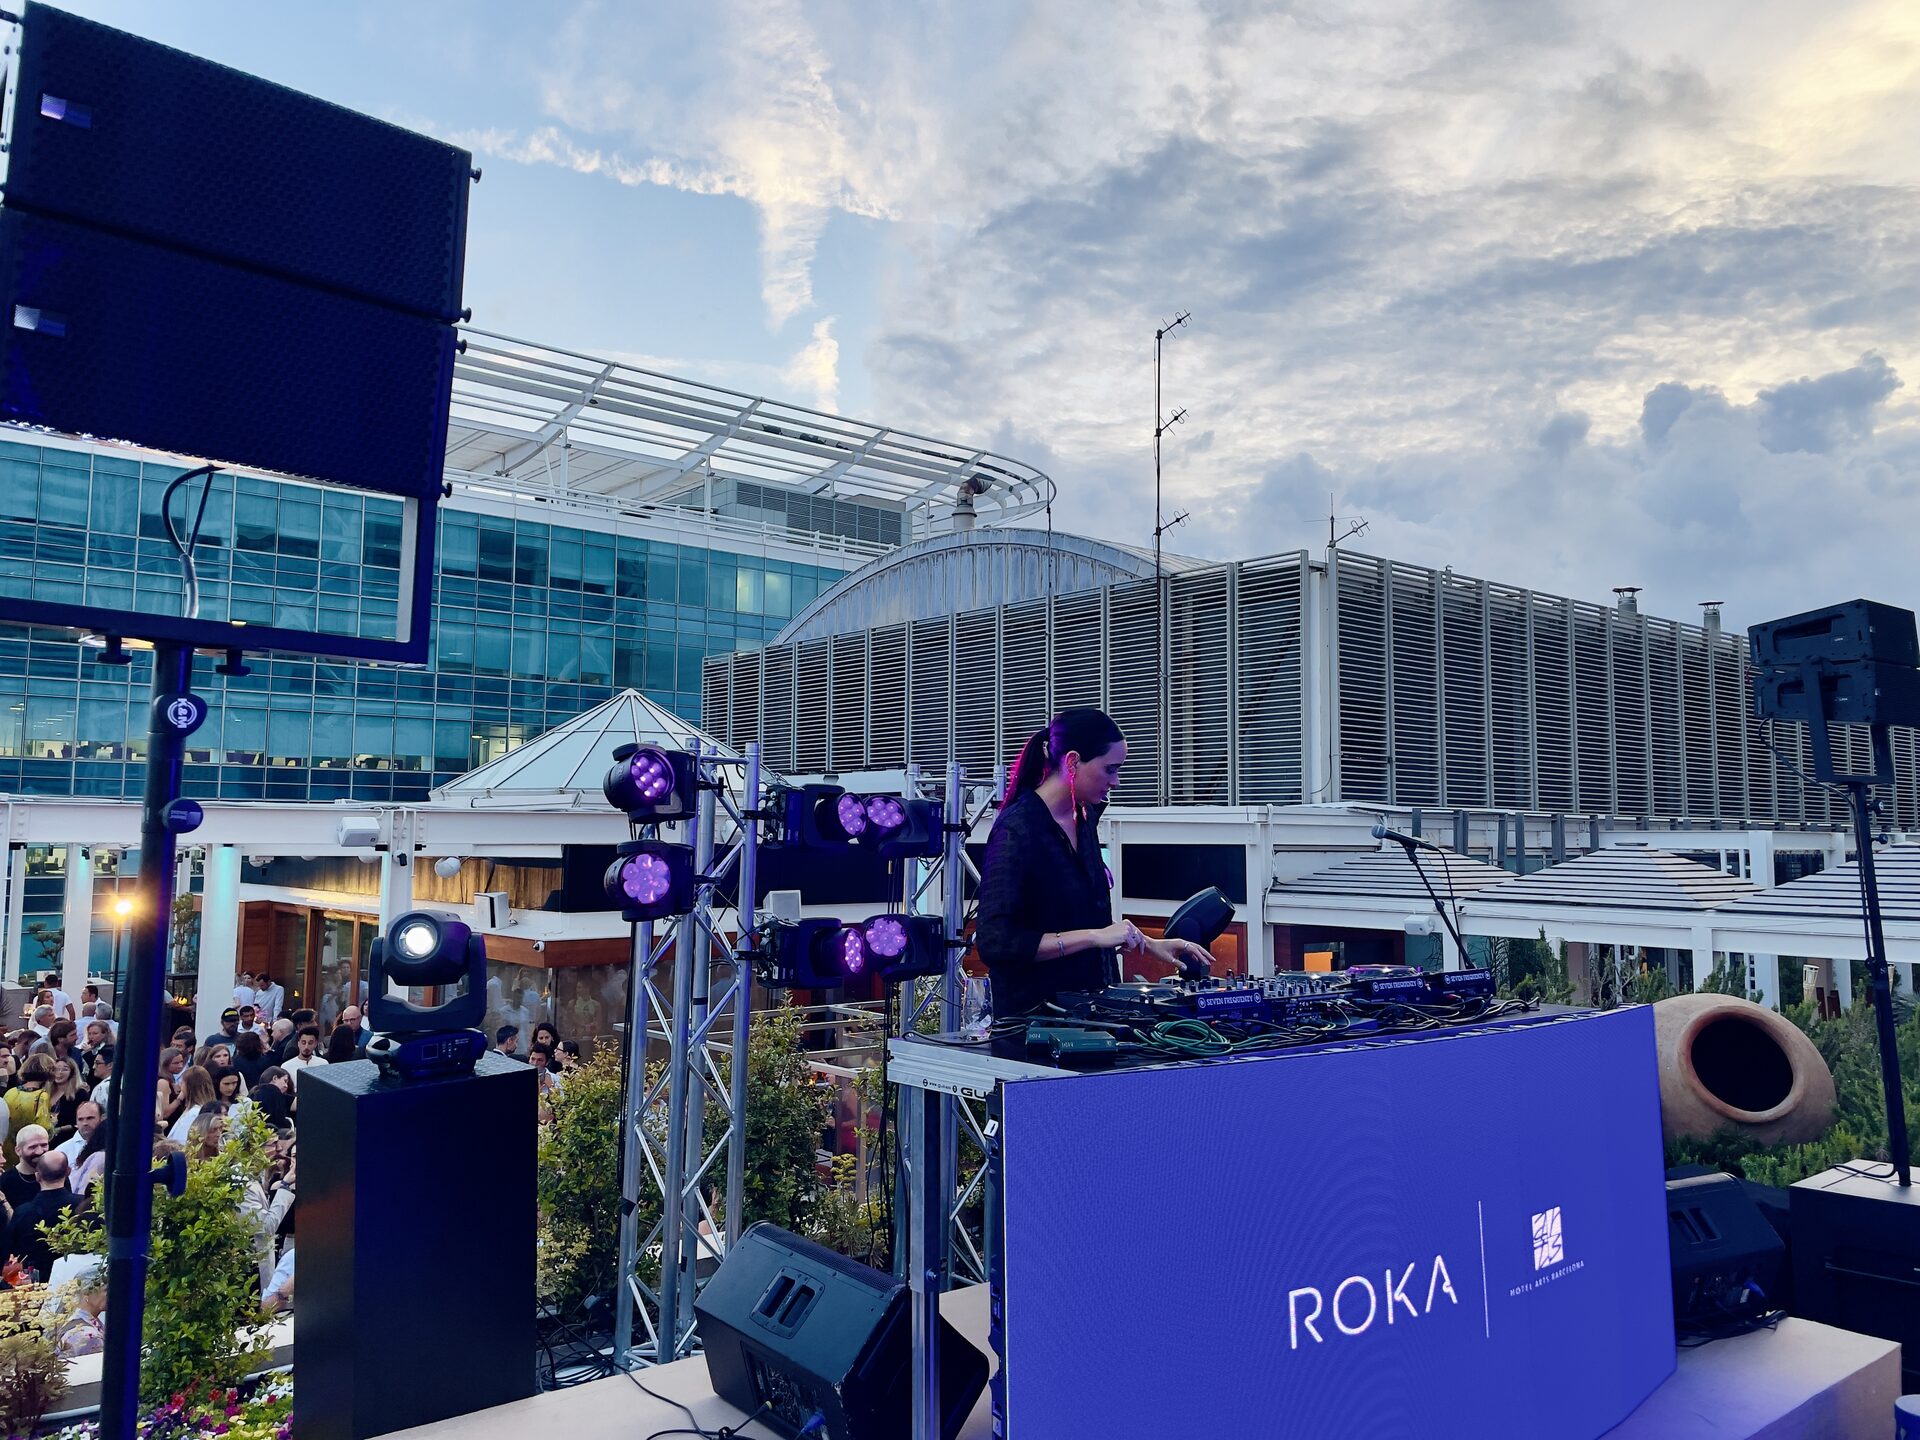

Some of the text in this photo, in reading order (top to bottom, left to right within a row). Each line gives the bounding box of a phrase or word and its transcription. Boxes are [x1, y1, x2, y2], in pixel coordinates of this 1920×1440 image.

[177, 698, 188, 729] K&M
[1206, 995, 1253, 1006] SEVEN FREQUENCY
[1509, 1260, 1585, 1296] HOTEL ARTS BARCELONA
[1288, 1255, 1458, 1349] ROKA
